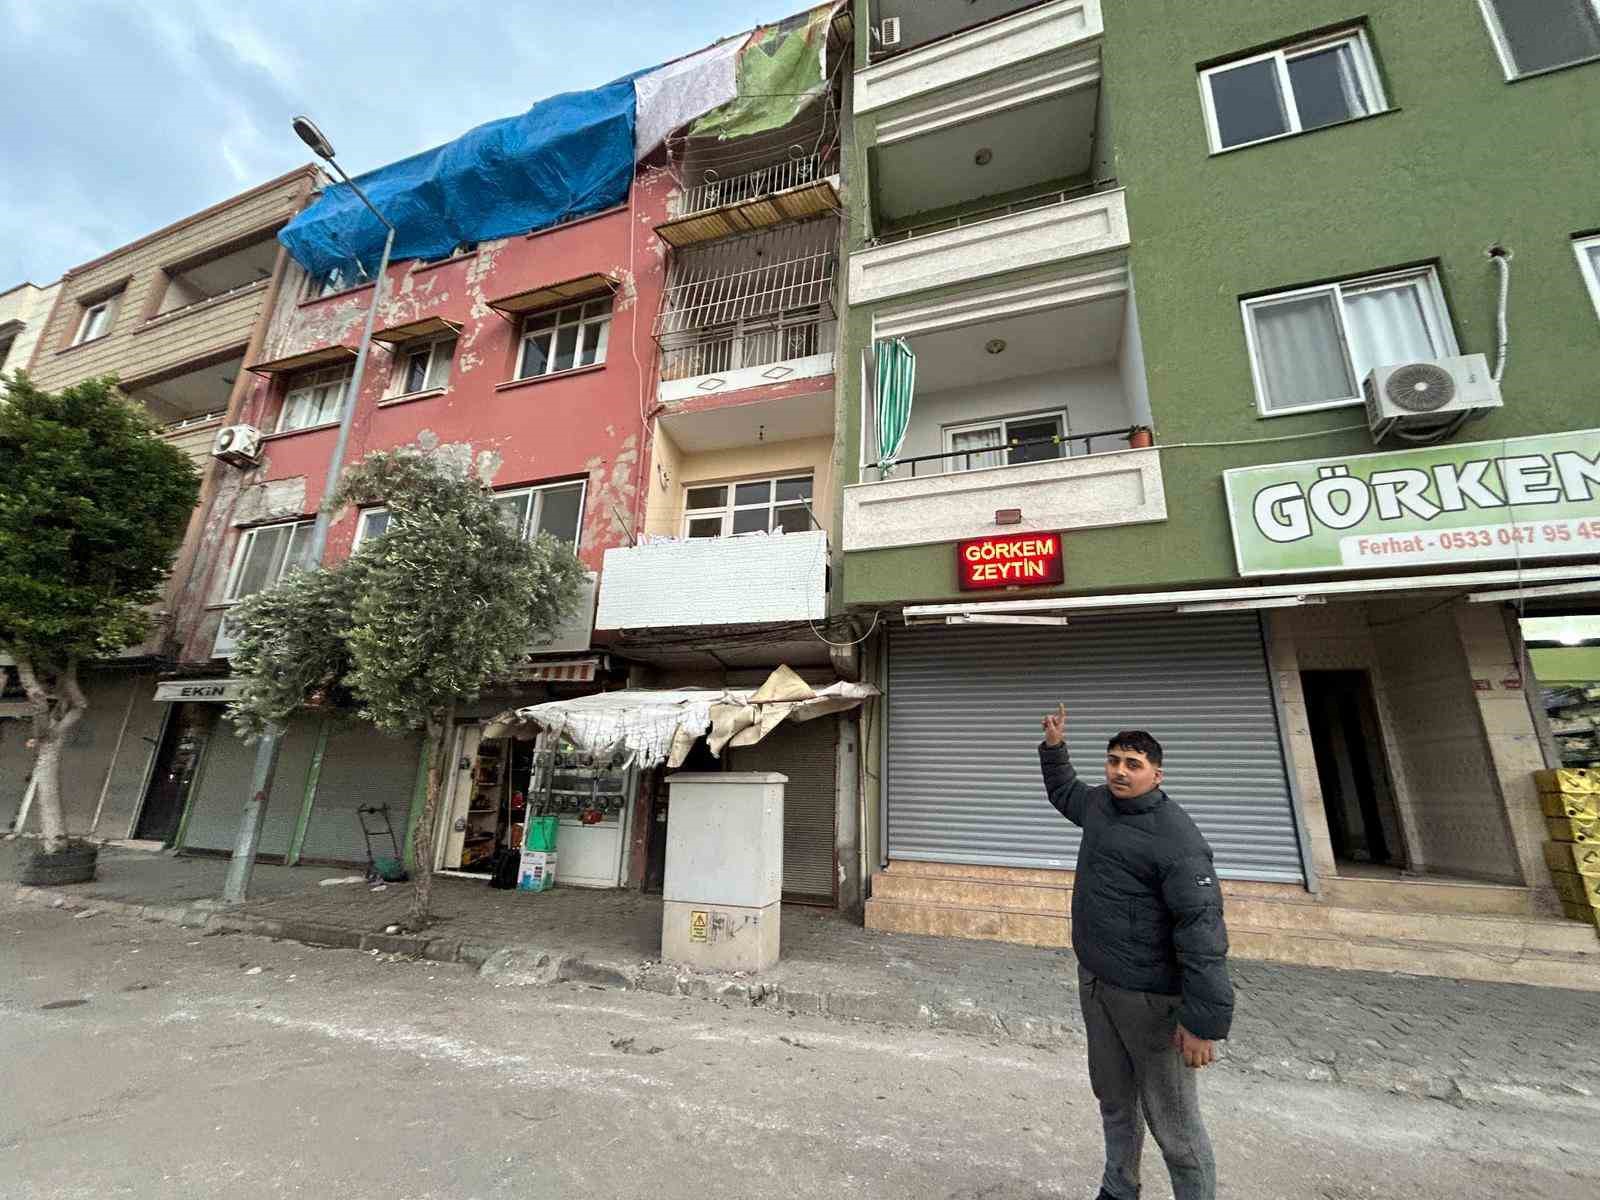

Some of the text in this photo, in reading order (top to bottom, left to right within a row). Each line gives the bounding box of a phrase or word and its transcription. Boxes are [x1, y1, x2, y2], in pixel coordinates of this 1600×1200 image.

[965, 539, 1053, 561] GÖRKEM
[1358, 535, 1424, 555] Ferhat
[1440, 528, 1492, 550] 0533
[1497, 525, 1534, 545] 047
[1542, 523, 1571, 542] 95
[972, 558, 1045, 581] ZEYTİN
